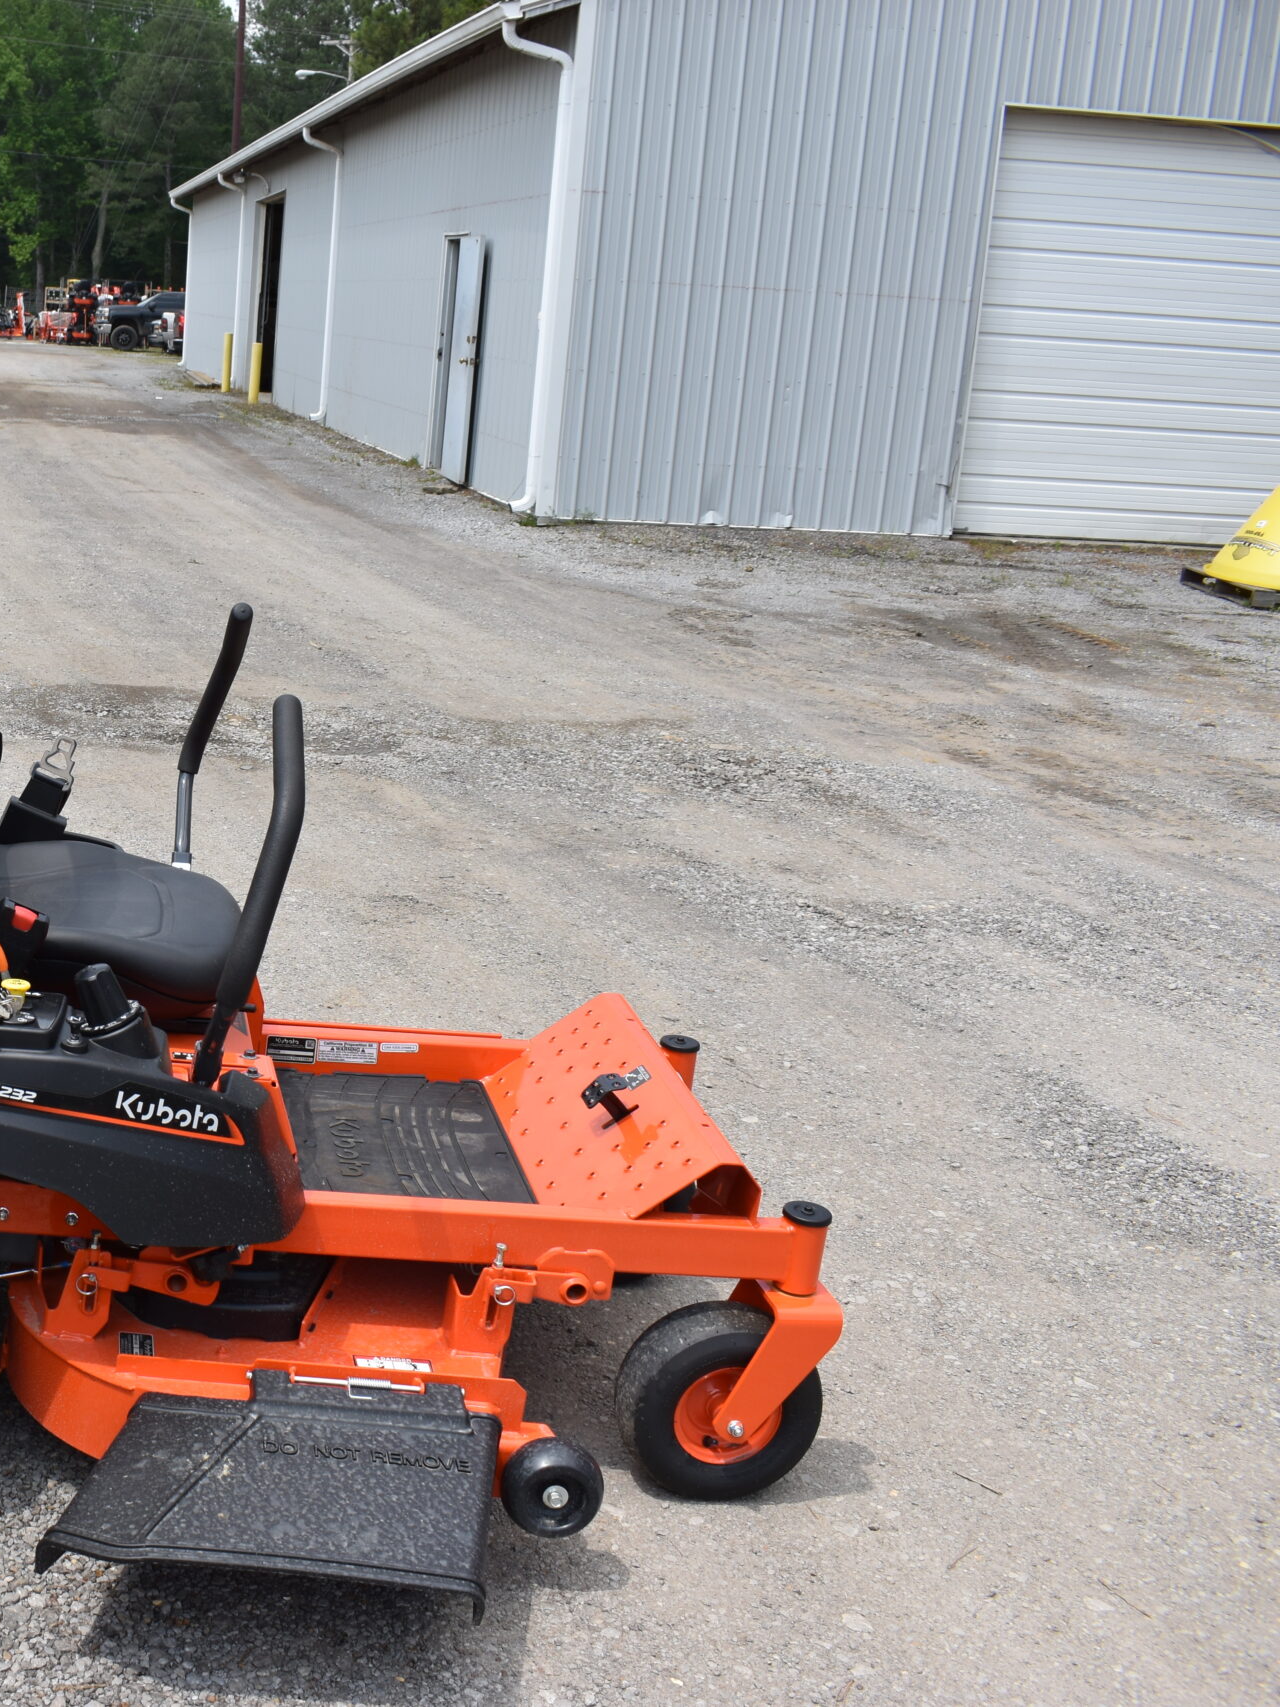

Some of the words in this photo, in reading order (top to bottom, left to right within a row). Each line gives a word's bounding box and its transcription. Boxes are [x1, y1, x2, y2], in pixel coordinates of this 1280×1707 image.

[115, 1090, 220, 1133] Kubota
[328, 1116, 370, 1178] Kubota
[262, 1440, 299, 1456] DO
[314, 1445, 360, 1461] NOT
[371, 1450, 471, 1473] REMOVE
